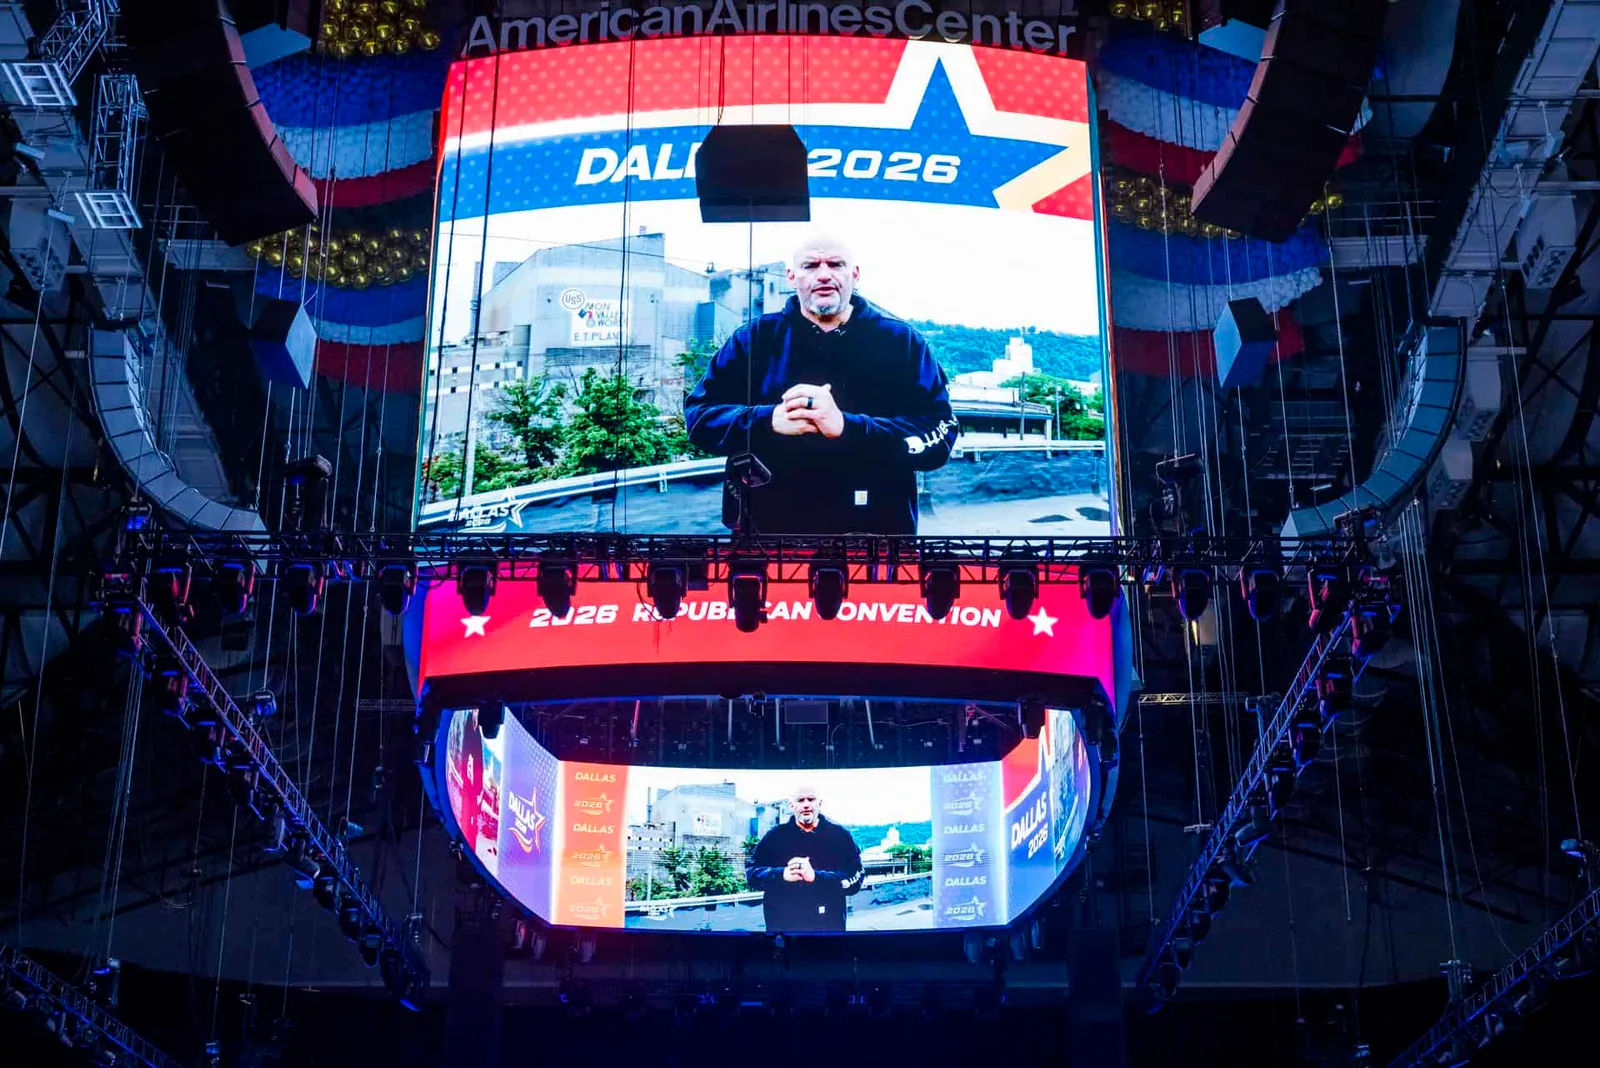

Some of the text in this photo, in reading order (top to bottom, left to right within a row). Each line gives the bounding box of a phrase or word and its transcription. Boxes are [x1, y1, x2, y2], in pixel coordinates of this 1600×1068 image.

[574, 142, 961, 186] DALL 2026
[575, 771, 616, 783] DALLAS
[1011, 791, 1047, 851] DALLAS
[573, 823, 614, 834] DALLAS
[944, 823, 986, 835] DALLAS
[945, 875, 987, 887] DALLAS
